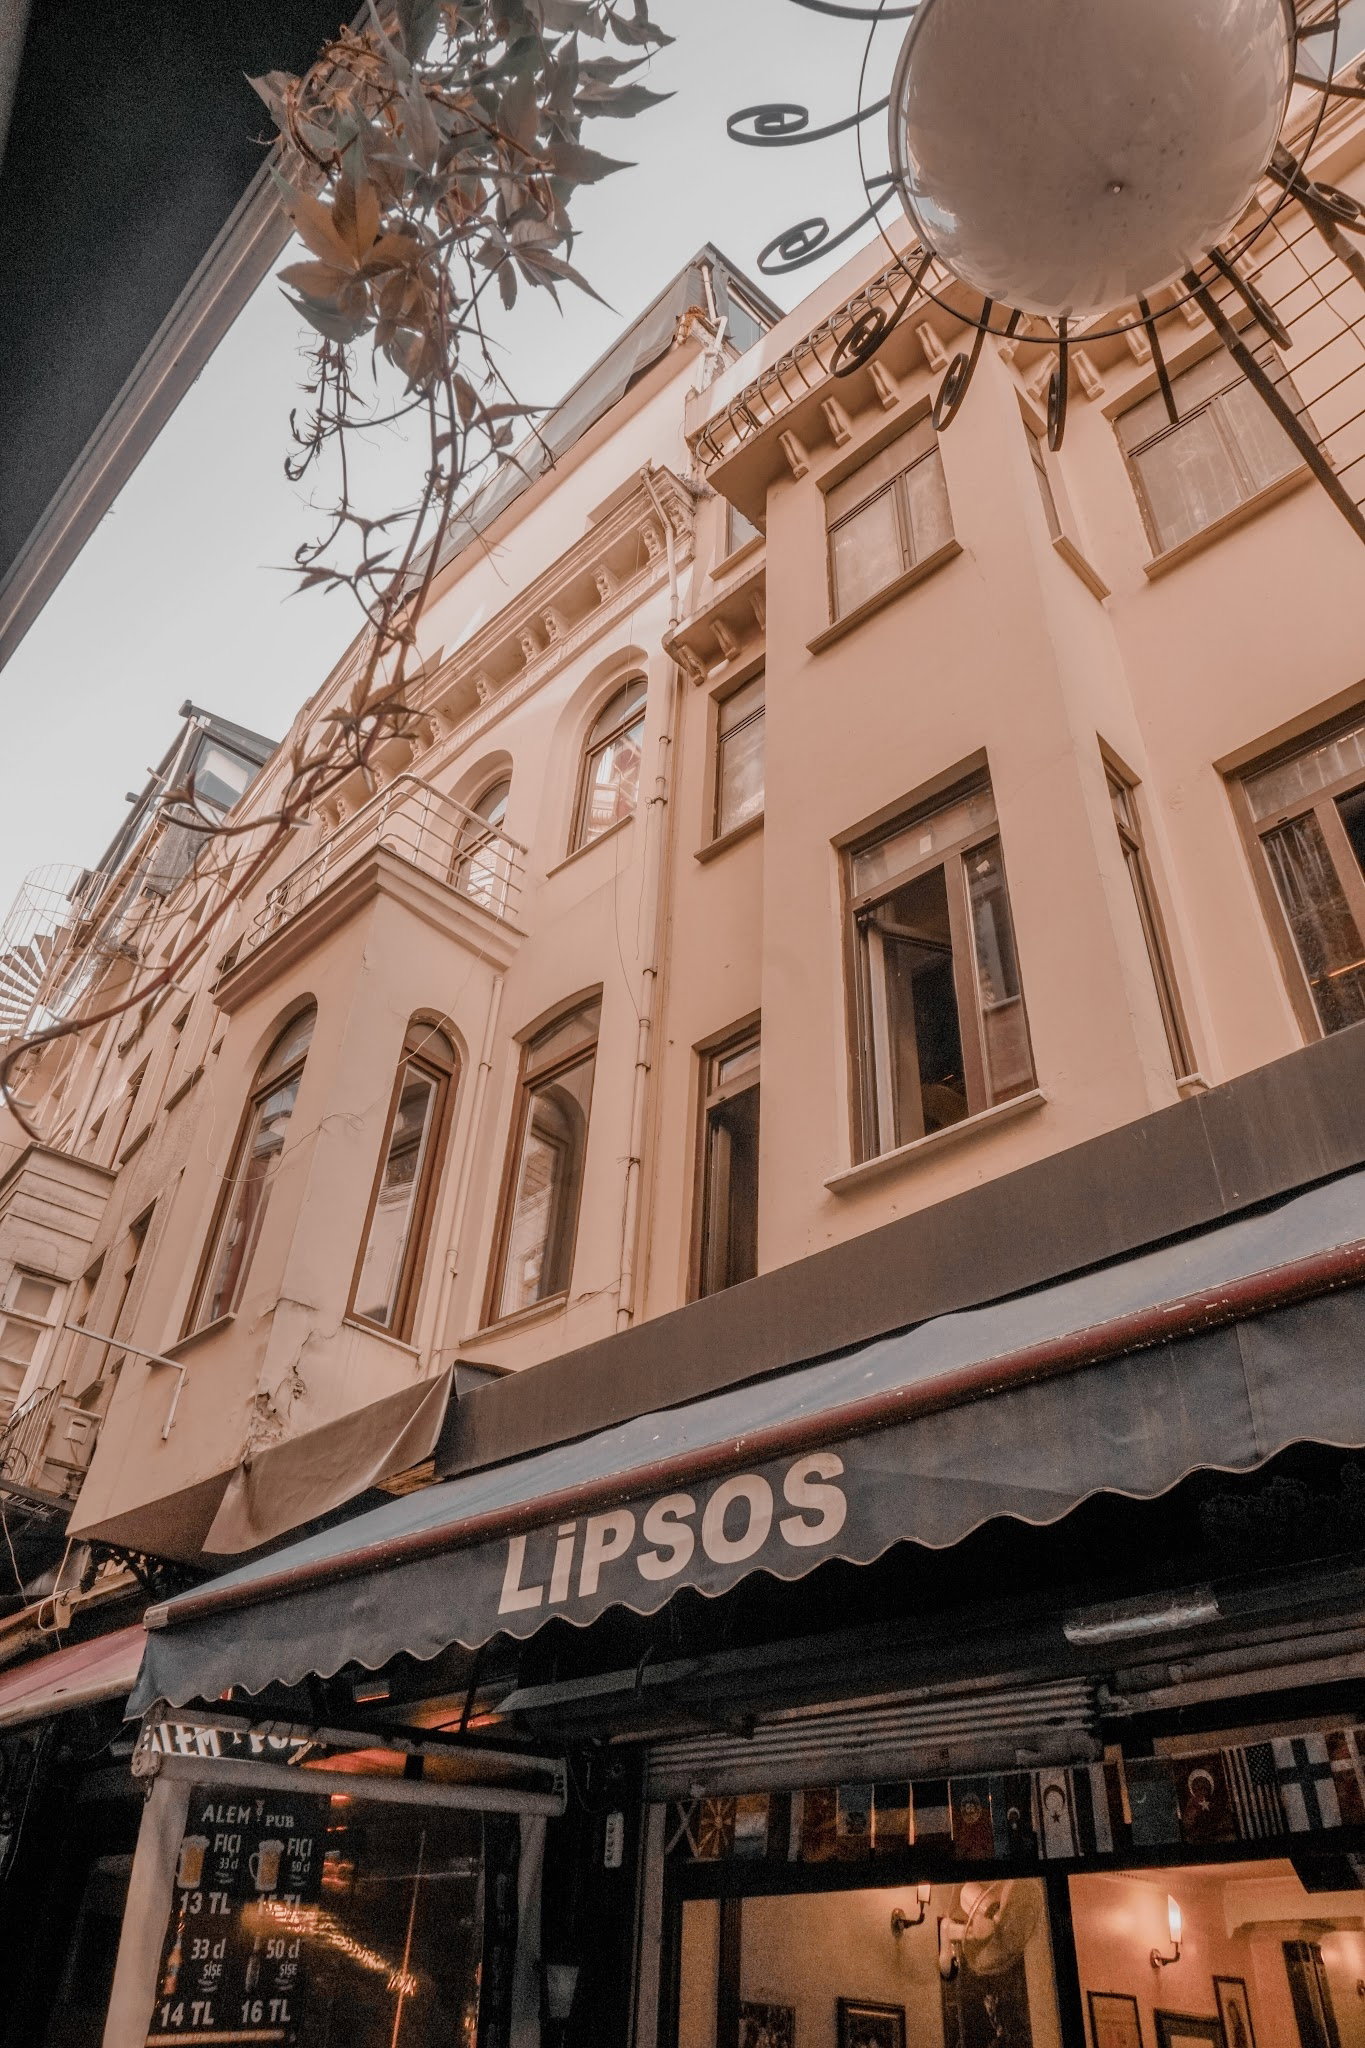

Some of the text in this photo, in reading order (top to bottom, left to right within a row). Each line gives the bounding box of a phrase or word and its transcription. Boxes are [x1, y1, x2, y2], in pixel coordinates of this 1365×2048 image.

[498, 1452, 847, 1615] LiPSOS
[201, 1804, 295, 1828] ALEM PUB
[180, 1891, 231, 1916] 13 TL
[190, 1937, 227, 1960] 33 cl
[266, 1938, 301, 1959] 50 cl
[161, 2001, 215, 2027] 14 TL
[241, 2000, 291, 2024] 16 TL
